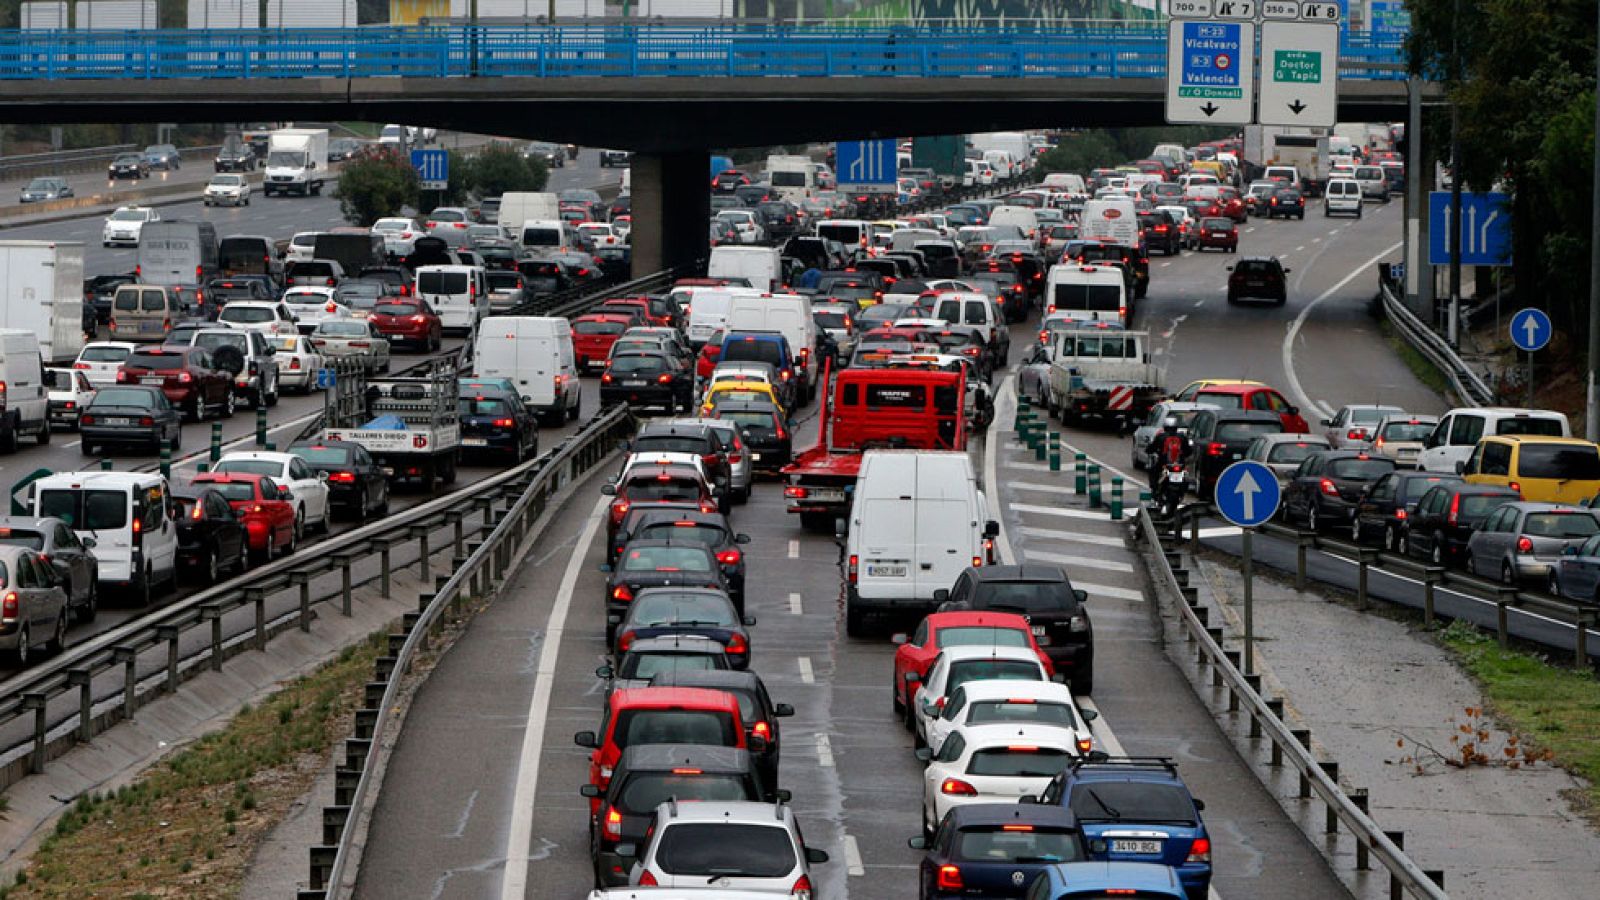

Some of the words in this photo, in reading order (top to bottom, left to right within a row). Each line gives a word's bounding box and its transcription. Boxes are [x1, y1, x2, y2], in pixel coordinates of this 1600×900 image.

[1175, 2, 1194, 12] 700
[1241, 4, 1250, 15] 7
[1326, 6, 1336, 18] 8
[1280, 60, 1315, 69] Doctor
[1186, 72, 1235, 84] Valencia
[1291, 71, 1318, 80] Tapia
[384, 432, 407, 440] DIEGO
